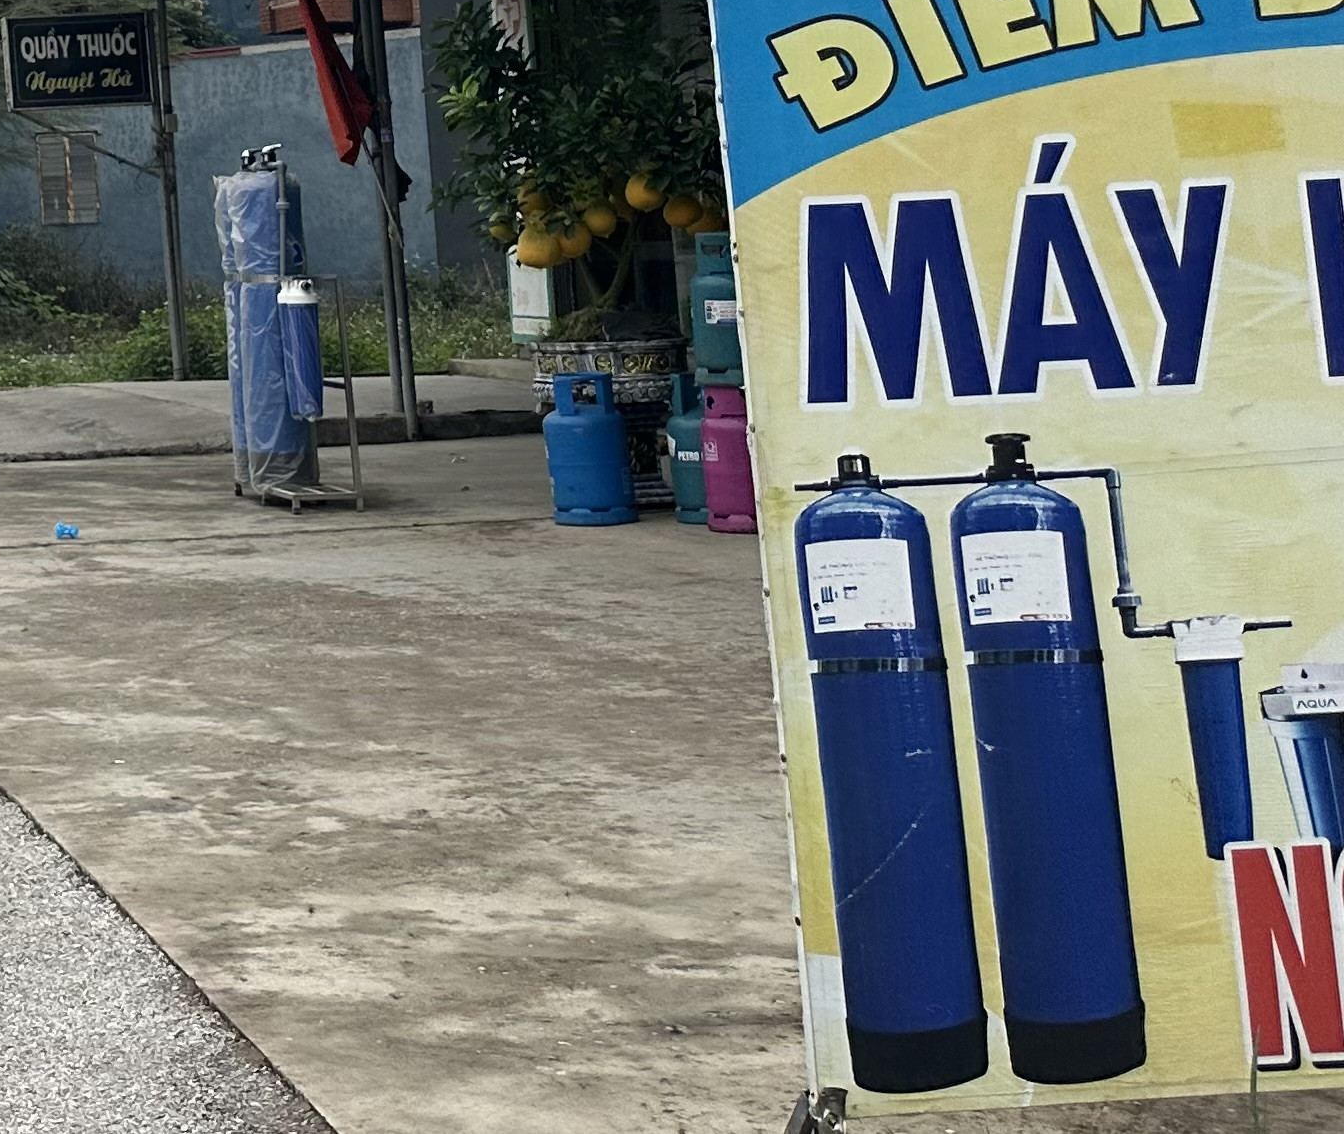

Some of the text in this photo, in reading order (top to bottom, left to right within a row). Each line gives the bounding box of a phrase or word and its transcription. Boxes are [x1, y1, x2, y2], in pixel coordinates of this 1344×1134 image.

[20, 24, 137, 63] QUẦY THUỐC
[25, 68, 134, 94] Nguyệt Hà
[802, 135, 1230, 408] MÁY
